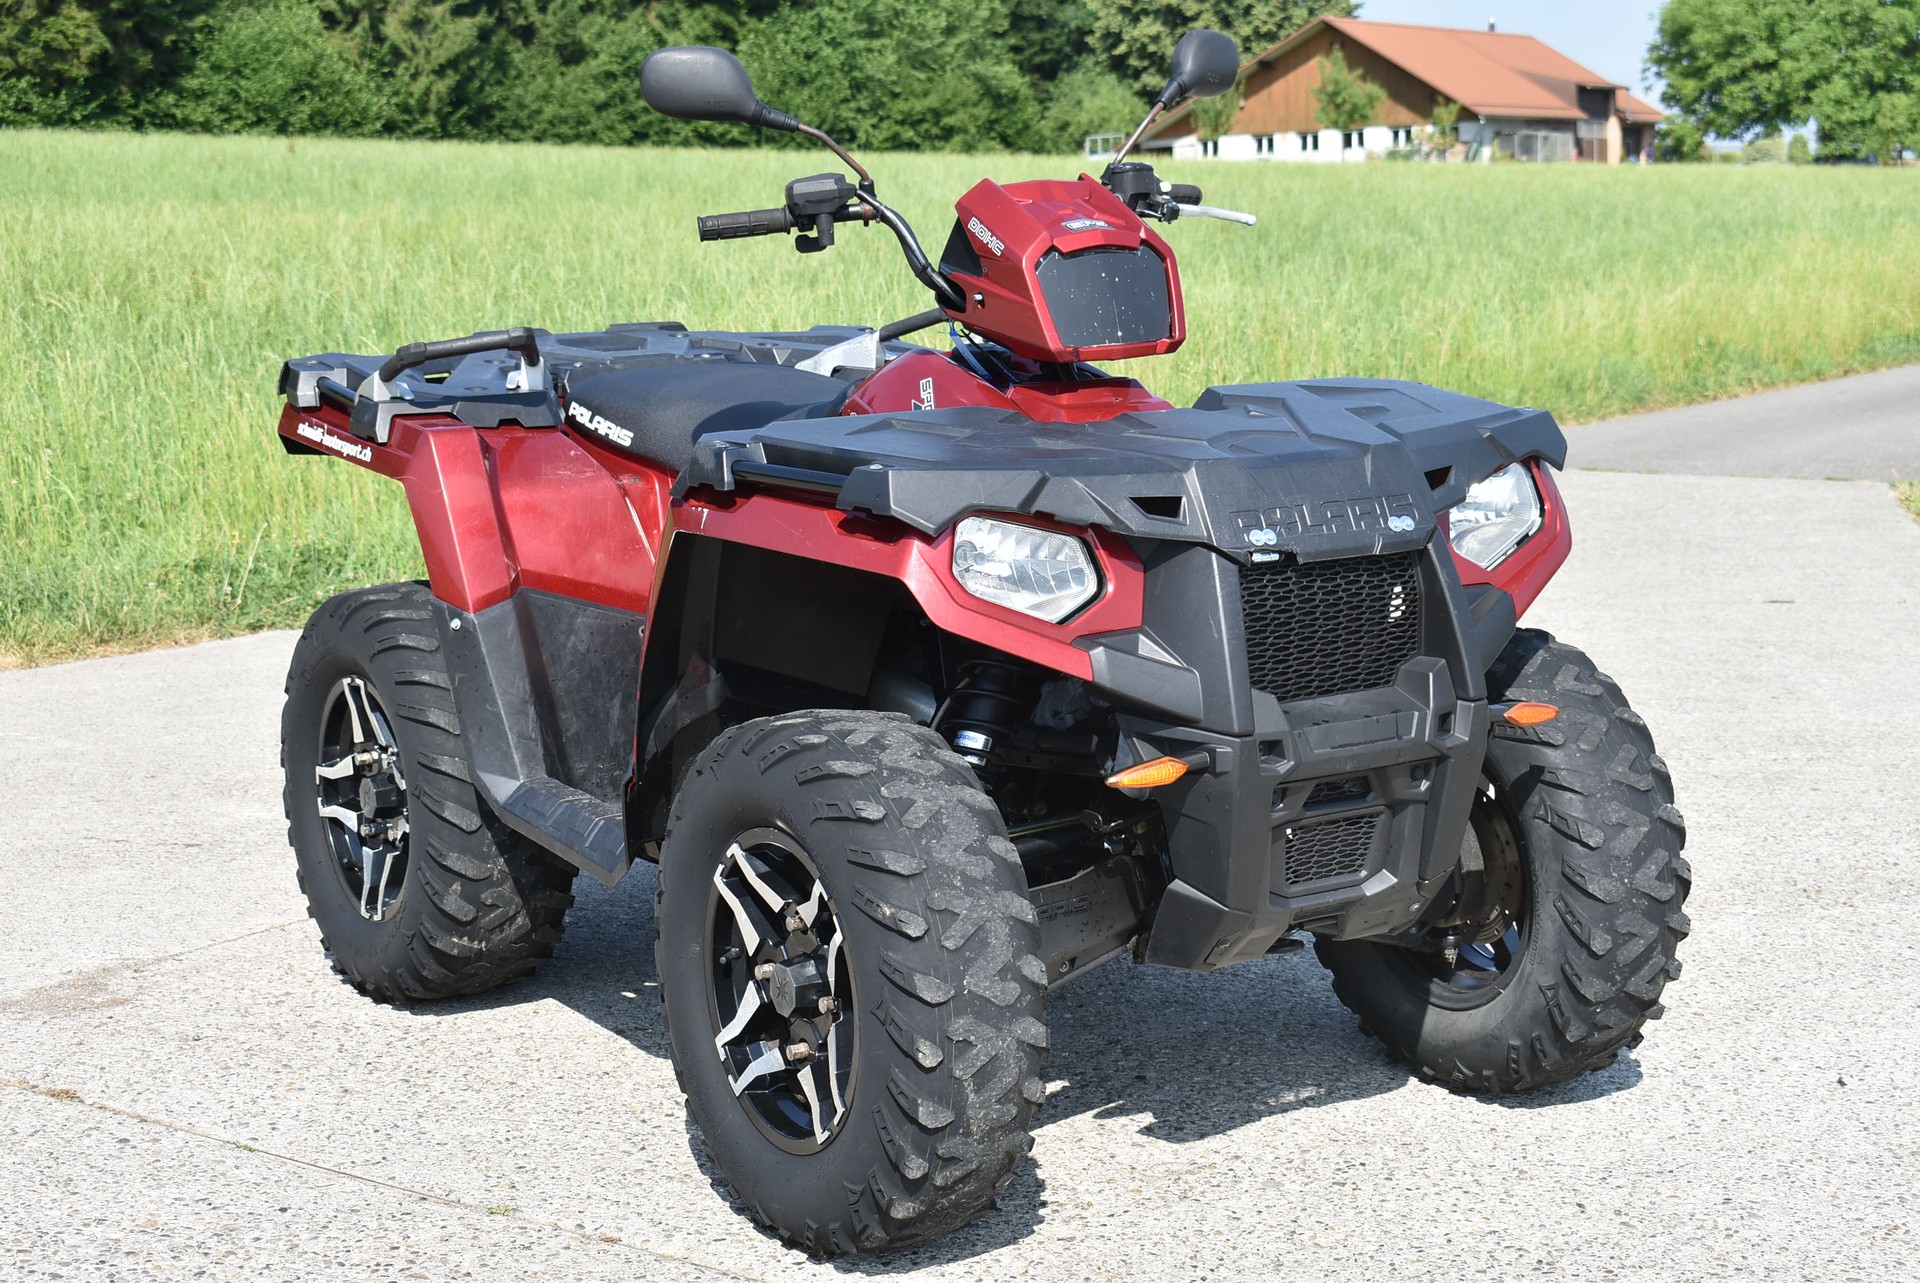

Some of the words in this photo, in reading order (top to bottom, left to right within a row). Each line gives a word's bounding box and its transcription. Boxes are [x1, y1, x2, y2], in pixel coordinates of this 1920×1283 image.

[968, 217, 1005, 256] DOHC
[568, 401, 634, 447] POLARIS
[1229, 493, 1419, 544] POLARIS
